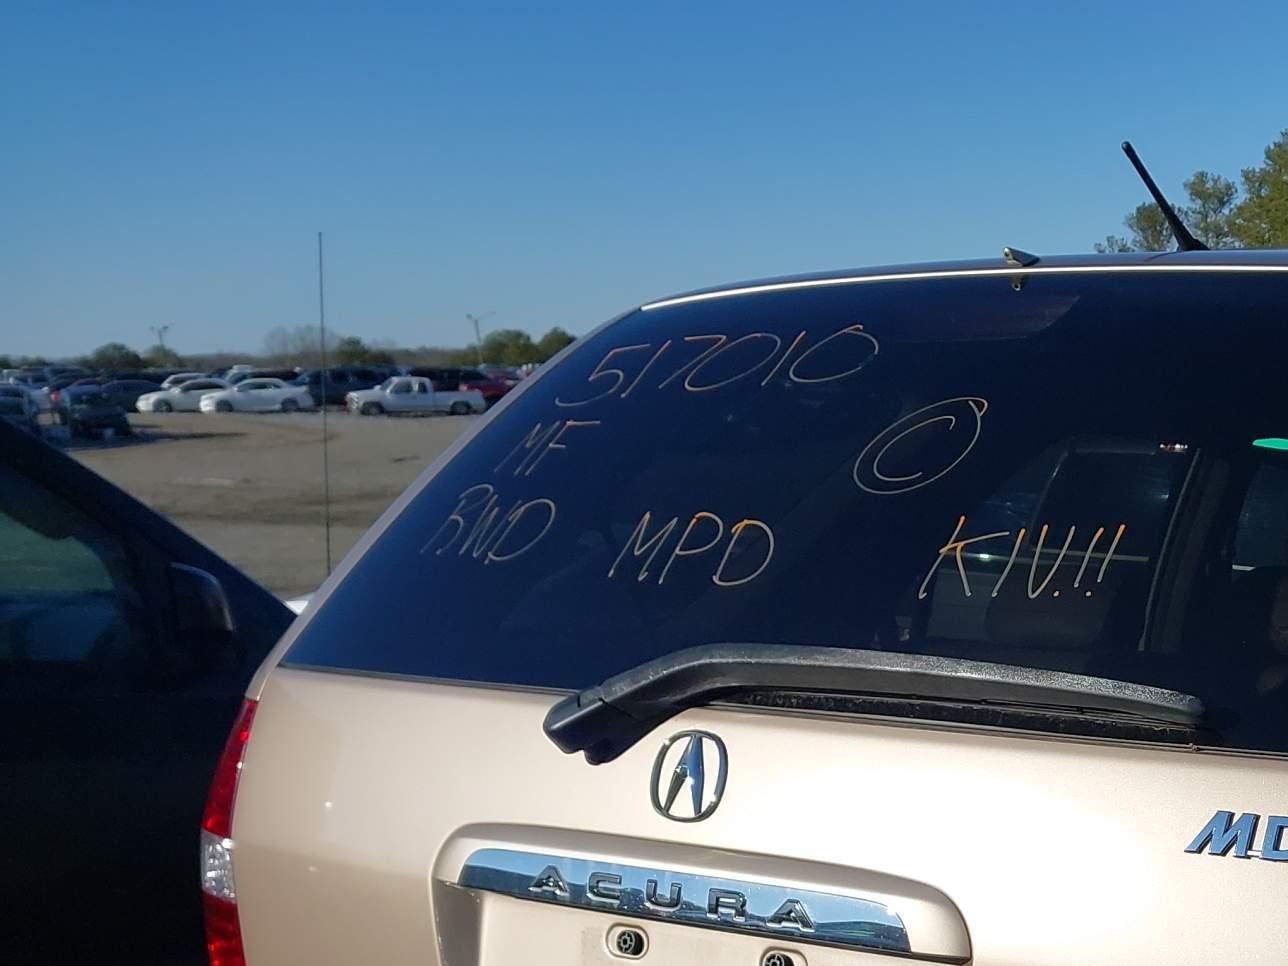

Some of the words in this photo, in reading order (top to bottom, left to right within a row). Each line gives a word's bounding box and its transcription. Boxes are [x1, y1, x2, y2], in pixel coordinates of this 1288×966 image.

[554, 324, 878, 406] 517010
[607, 511, 775, 586] MPD
[527, 864, 816, 933] ACURA
